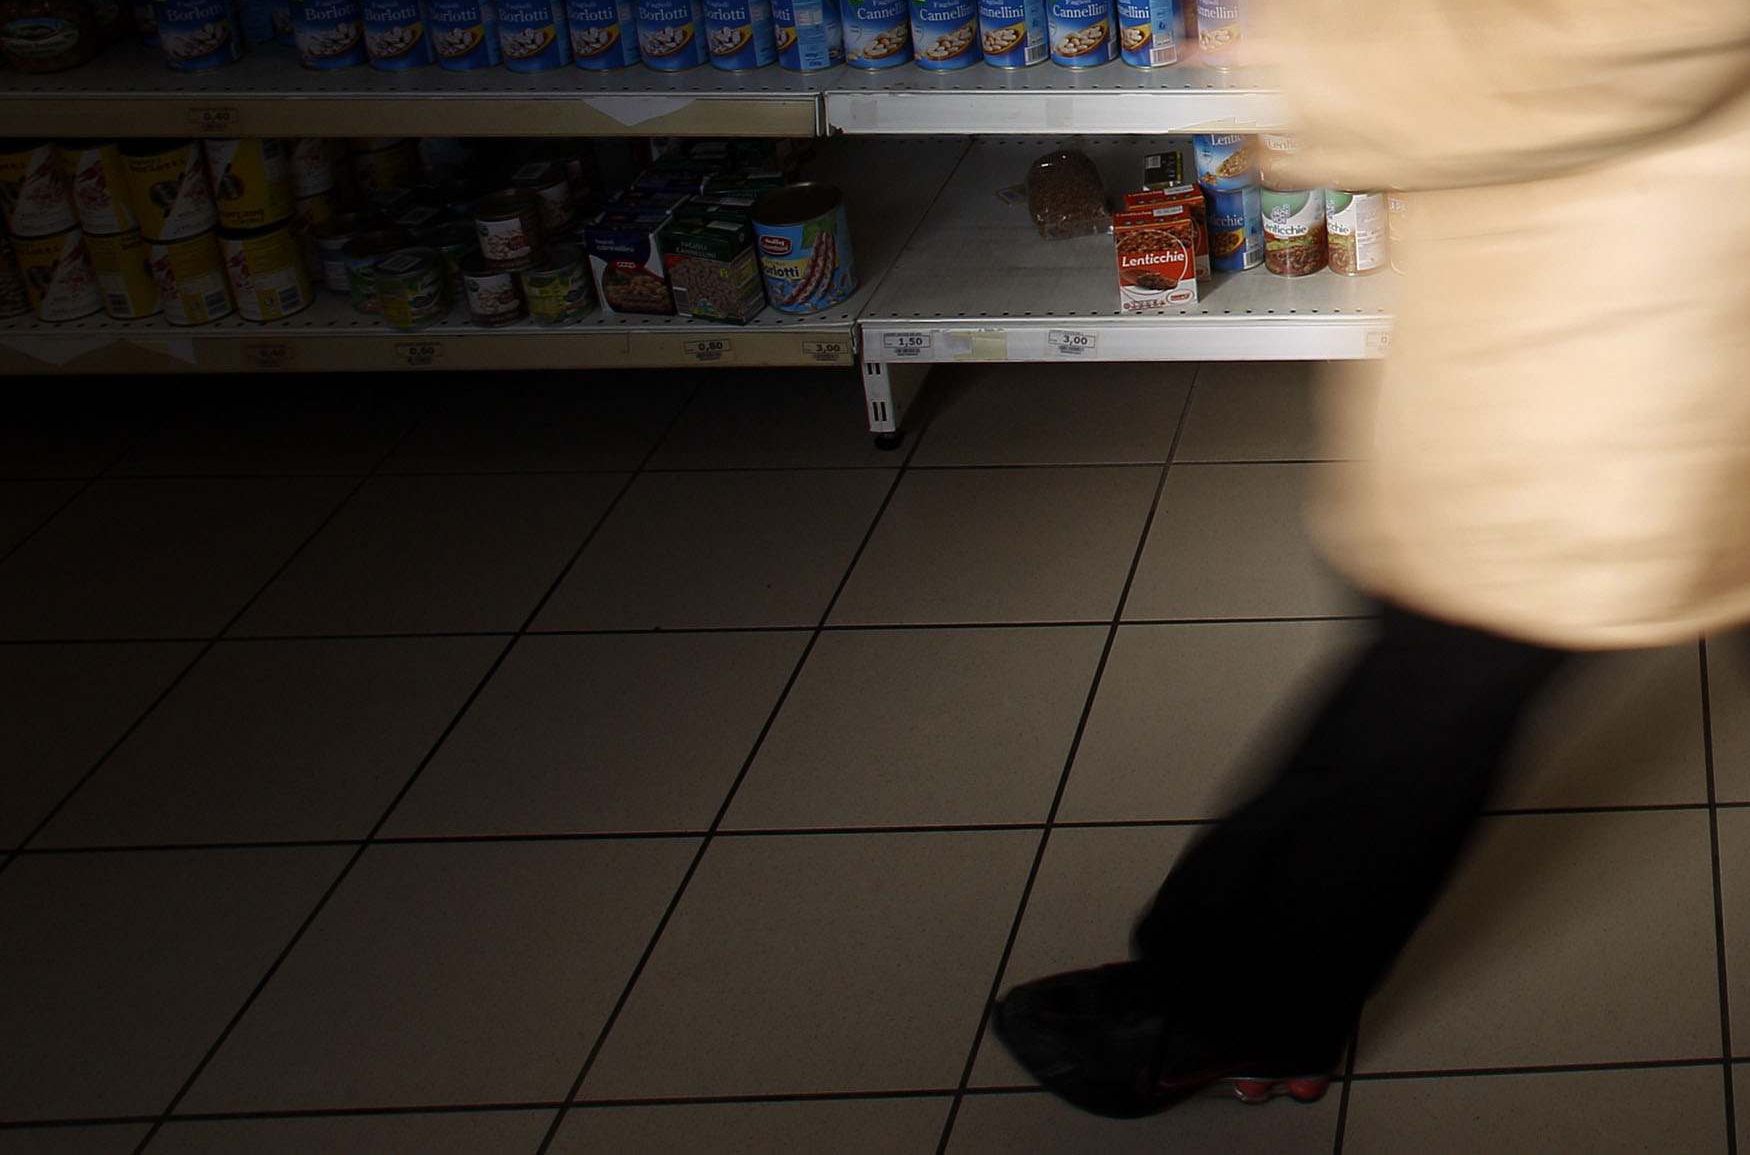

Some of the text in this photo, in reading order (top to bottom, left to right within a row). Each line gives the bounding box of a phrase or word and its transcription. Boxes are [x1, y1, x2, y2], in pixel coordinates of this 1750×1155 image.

[638, 6, 690, 22] Borlotti
[1052, 3, 1107, 19] Cannellini
[1122, 251, 1185, 268] Lenticchie
[898, 337, 923, 347] 1,50
[1063, 335, 1089, 346] 3,00
[816, 344, 841, 352] 3,00
